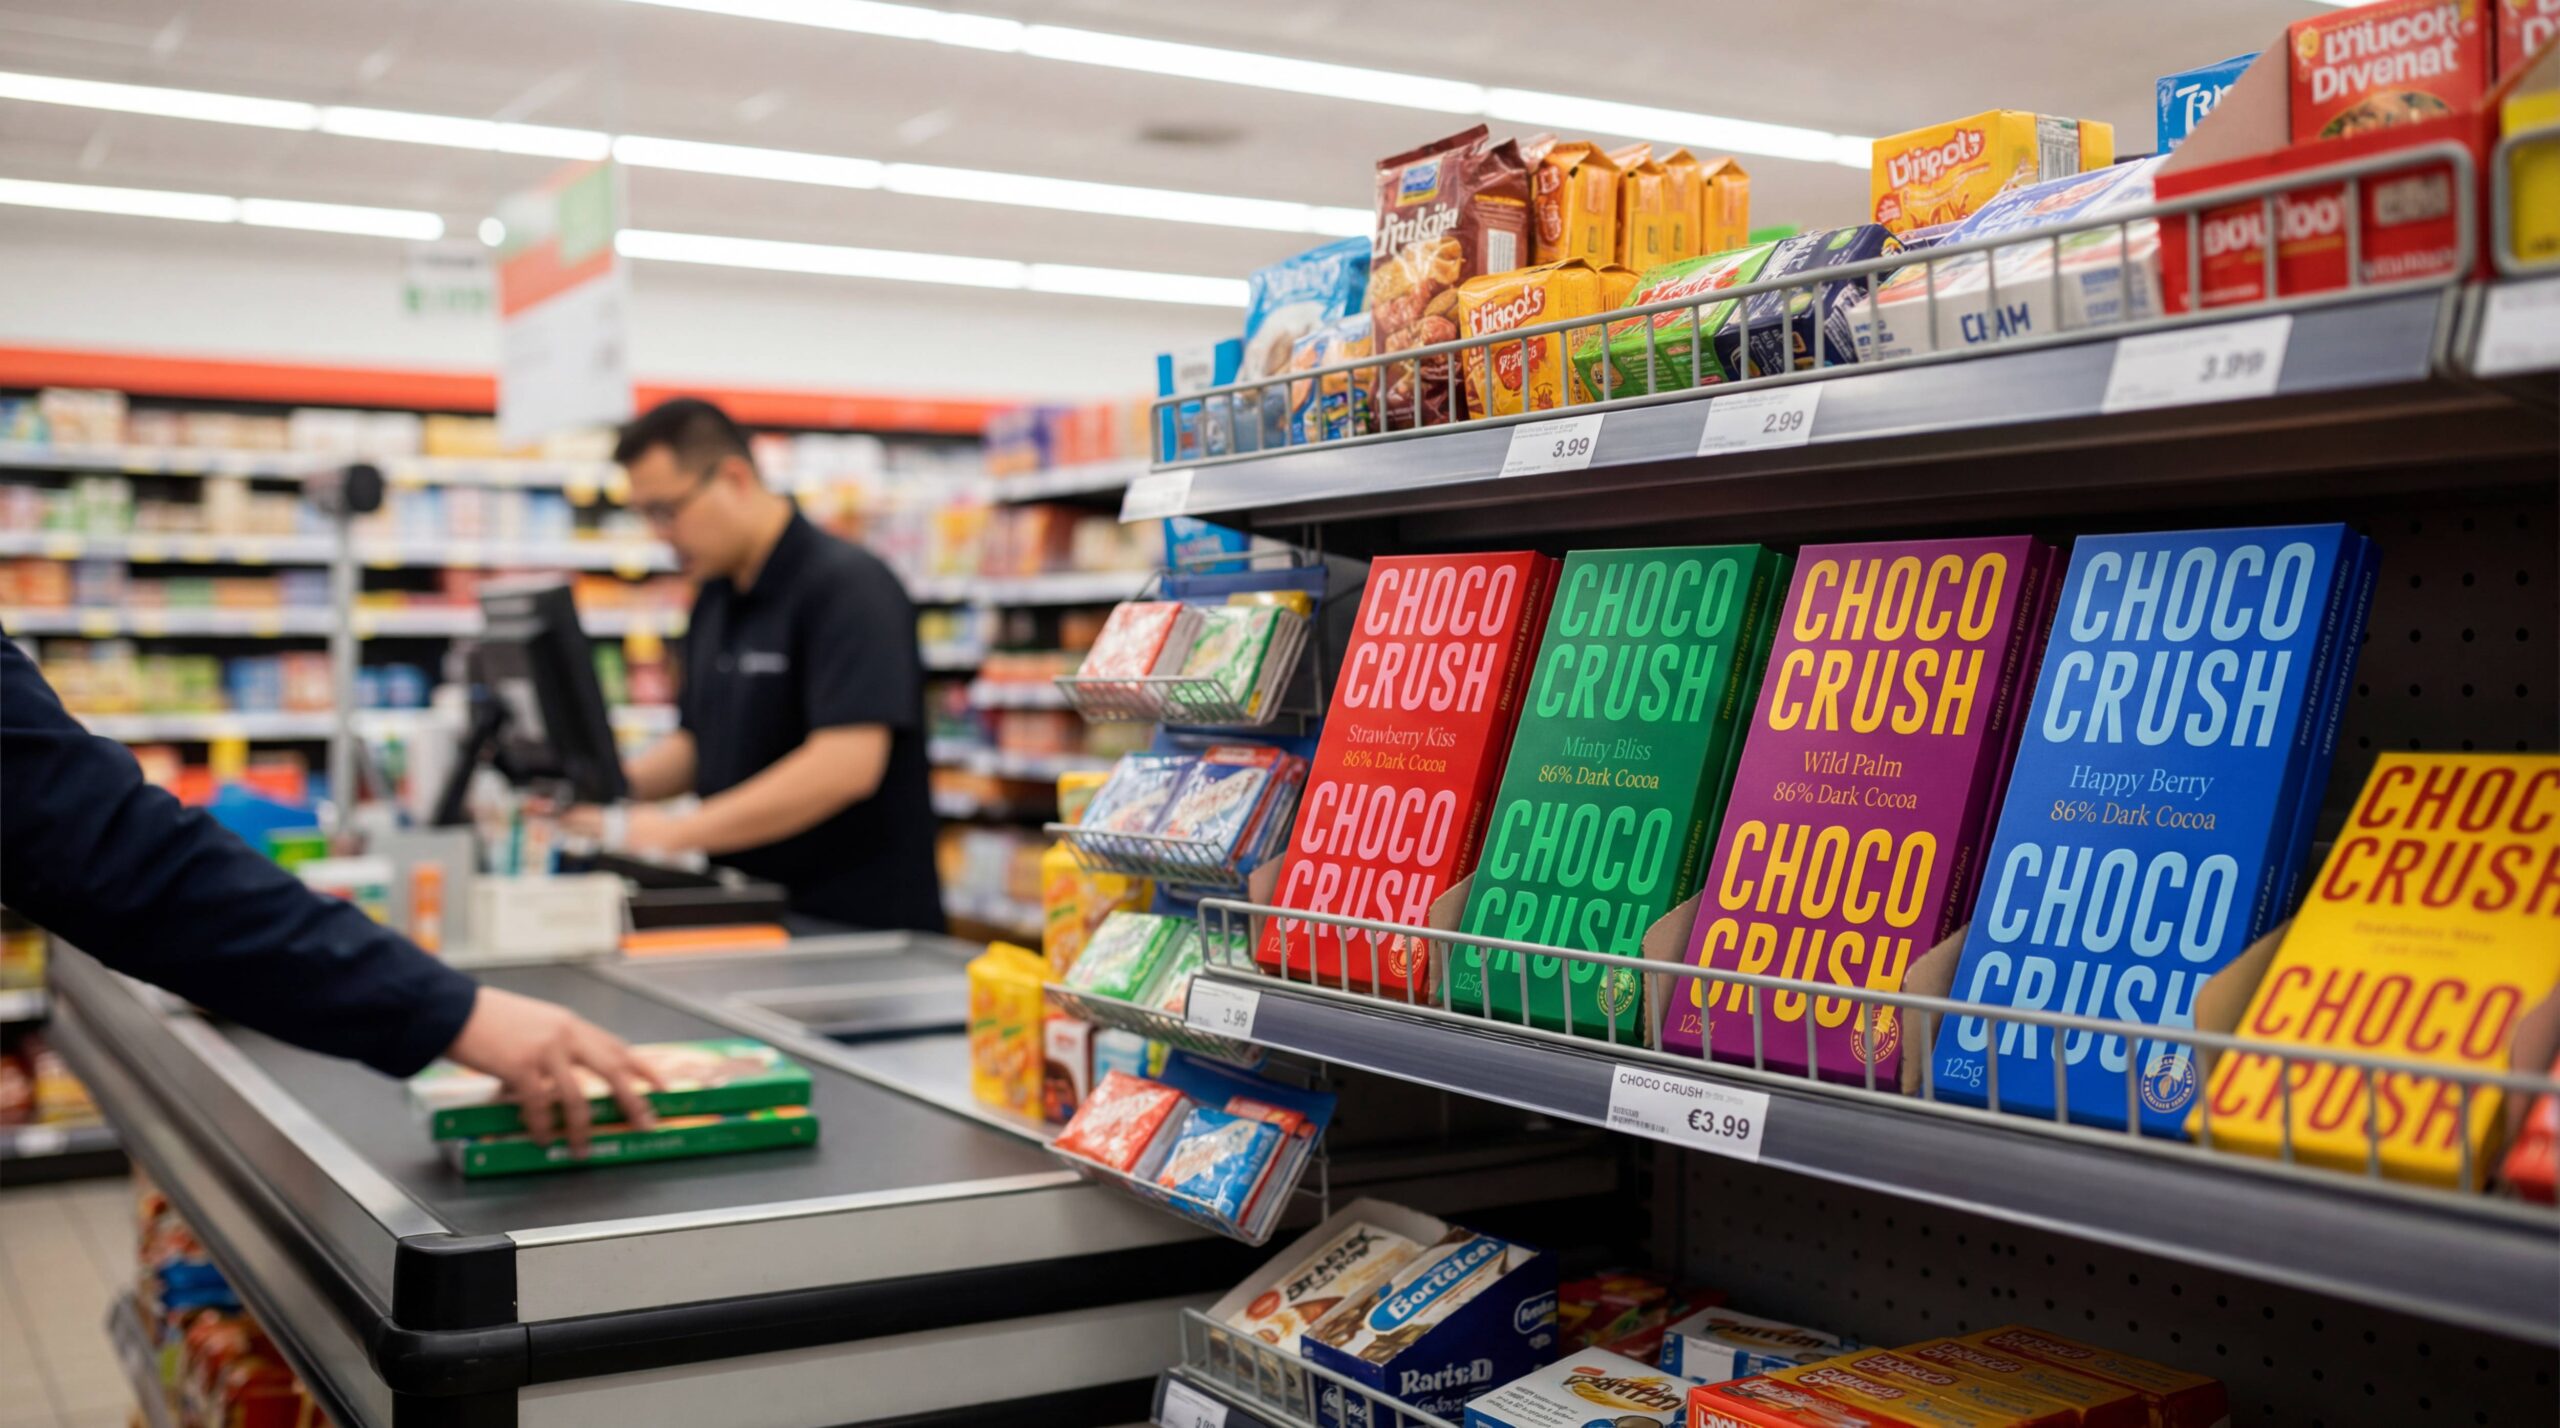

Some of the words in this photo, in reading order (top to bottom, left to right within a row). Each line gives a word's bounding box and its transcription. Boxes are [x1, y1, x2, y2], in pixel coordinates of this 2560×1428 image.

[1552, 437, 1590, 459] 3.99
[1762, 410, 1804, 434] 2.99
[1364, 564, 1517, 637] CHOCO
[1559, 558, 1739, 638] CHOCO
[1793, 552, 2007, 643] CHOCO
[2069, 541, 2316, 643] CHOCO
[1343, 641, 1498, 713] CRUSH
[1536, 643, 1719, 722] CRUSH
[1768, 648, 1985, 736] CRUSH
[2042, 648, 2292, 748] CRUSH
[1342, 750, 1372, 771] 86%
[1374, 750, 1405, 772] Dark
[1407, 754, 1447, 774] Cocoa
[1347, 723, 1424, 750] Strawberry
[1425, 727, 1457, 747] Kiss
[1561, 736, 1612, 764] Minty
[1613, 738, 1652, 761] Bliss
[1804, 750, 1849, 775] Wild
[1852, 753, 1903, 778] Palm
[1538, 764, 1573, 784] 86%
[1575, 766, 1612, 787] Dark
[1615, 769, 1660, 789] Cocoa
[1773, 781, 1814, 803] 86%
[1816, 783, 1860, 806] Dark
[1864, 786, 1918, 809] Cocoa
[2069, 764, 2145, 798] Happy
[2148, 768, 2215, 801] Berry
[1301, 780, 1457, 867] CHOCO
[1490, 799, 1673, 896] CHOCO
[2050, 799, 2097, 824] 86%
[2102, 802, 2151, 827] Dark
[2156, 805, 2216, 831] Cocoa
[1276, 859, 1436, 952] CRUSH
[1718, 819, 1937, 928] CHOCO
[1988, 842, 2239, 963] CHOCO
[1465, 886, 1650, 988] CRUSH
[1689, 917, 1913, 1033] CRUSH
[1223, 1007, 1248, 1028] 3.99
[1957, 950, 2215, 1081] CRUSH
[2252, 964, 2526, 1062] CHOCO
[1619, 1073, 1661, 1091] CHOCO
[1663, 1081, 1704, 1099] CRUSH
[1943, 1057, 1984, 1088] 125g
[1688, 1108, 1750, 1140] €3.99
